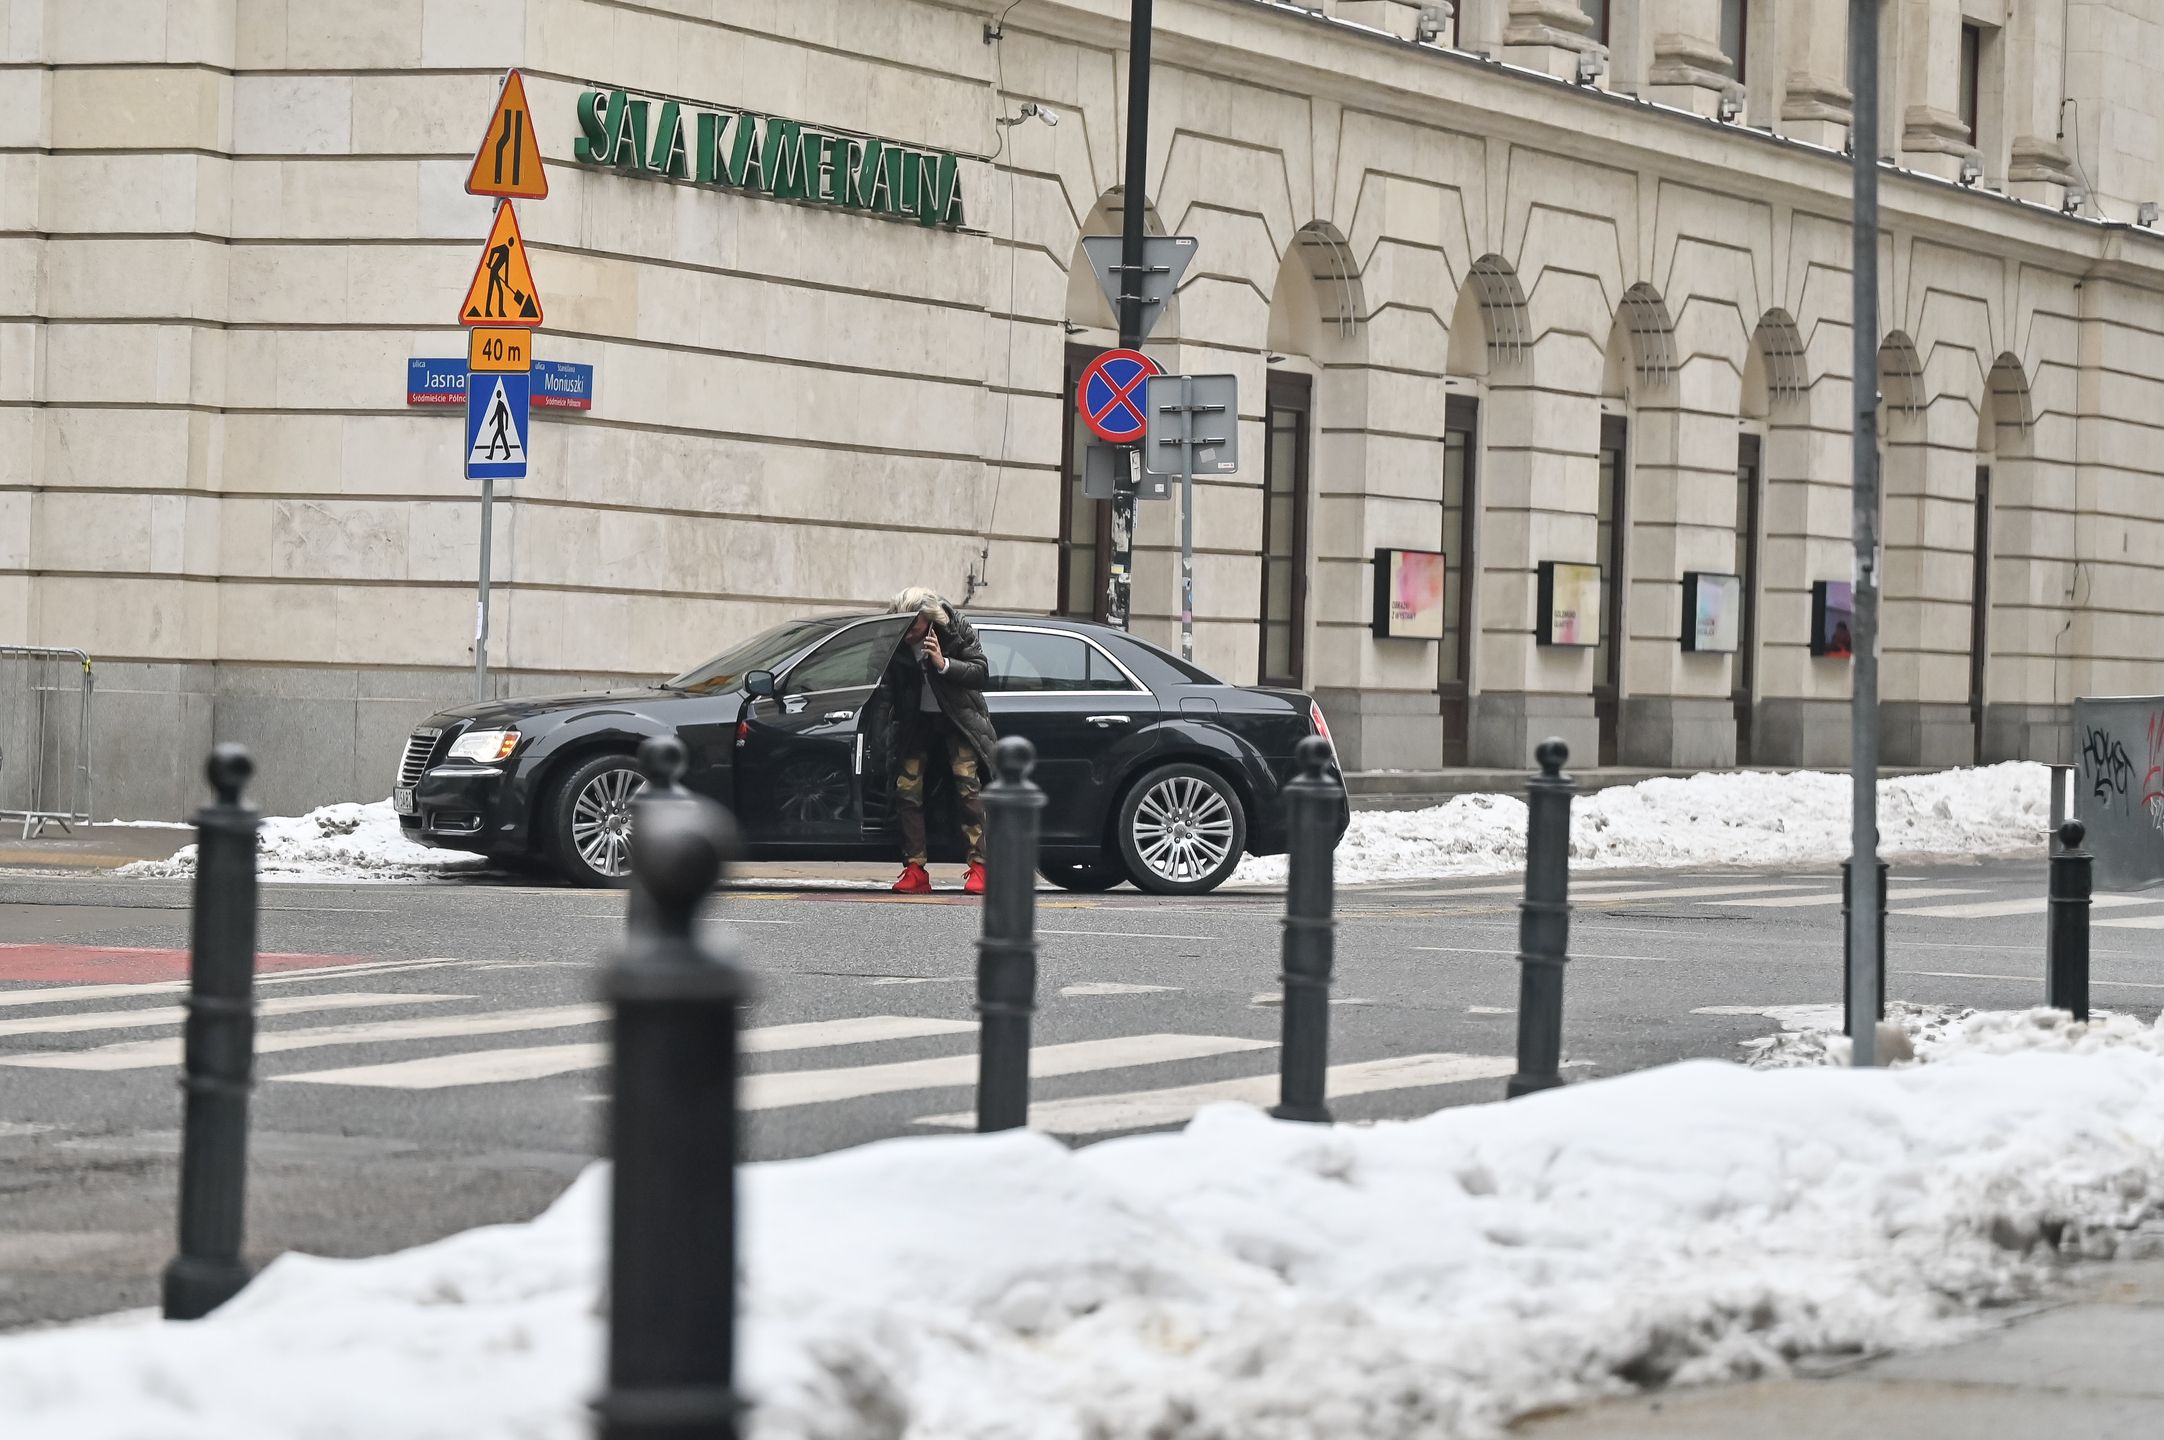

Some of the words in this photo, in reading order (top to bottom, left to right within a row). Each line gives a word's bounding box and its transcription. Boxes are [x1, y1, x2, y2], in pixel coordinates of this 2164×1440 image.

[574, 90, 689, 178] SALA
[696, 112, 967, 227] KAMERALNA
[482, 338, 503, 361] 40
[508, 345, 521, 362] m
[412, 360, 426, 368] ulica
[424, 370, 465, 388] Jasna
[544, 373, 584, 393] Moniuszki
[412, 393, 446, 402] Śródmieście
